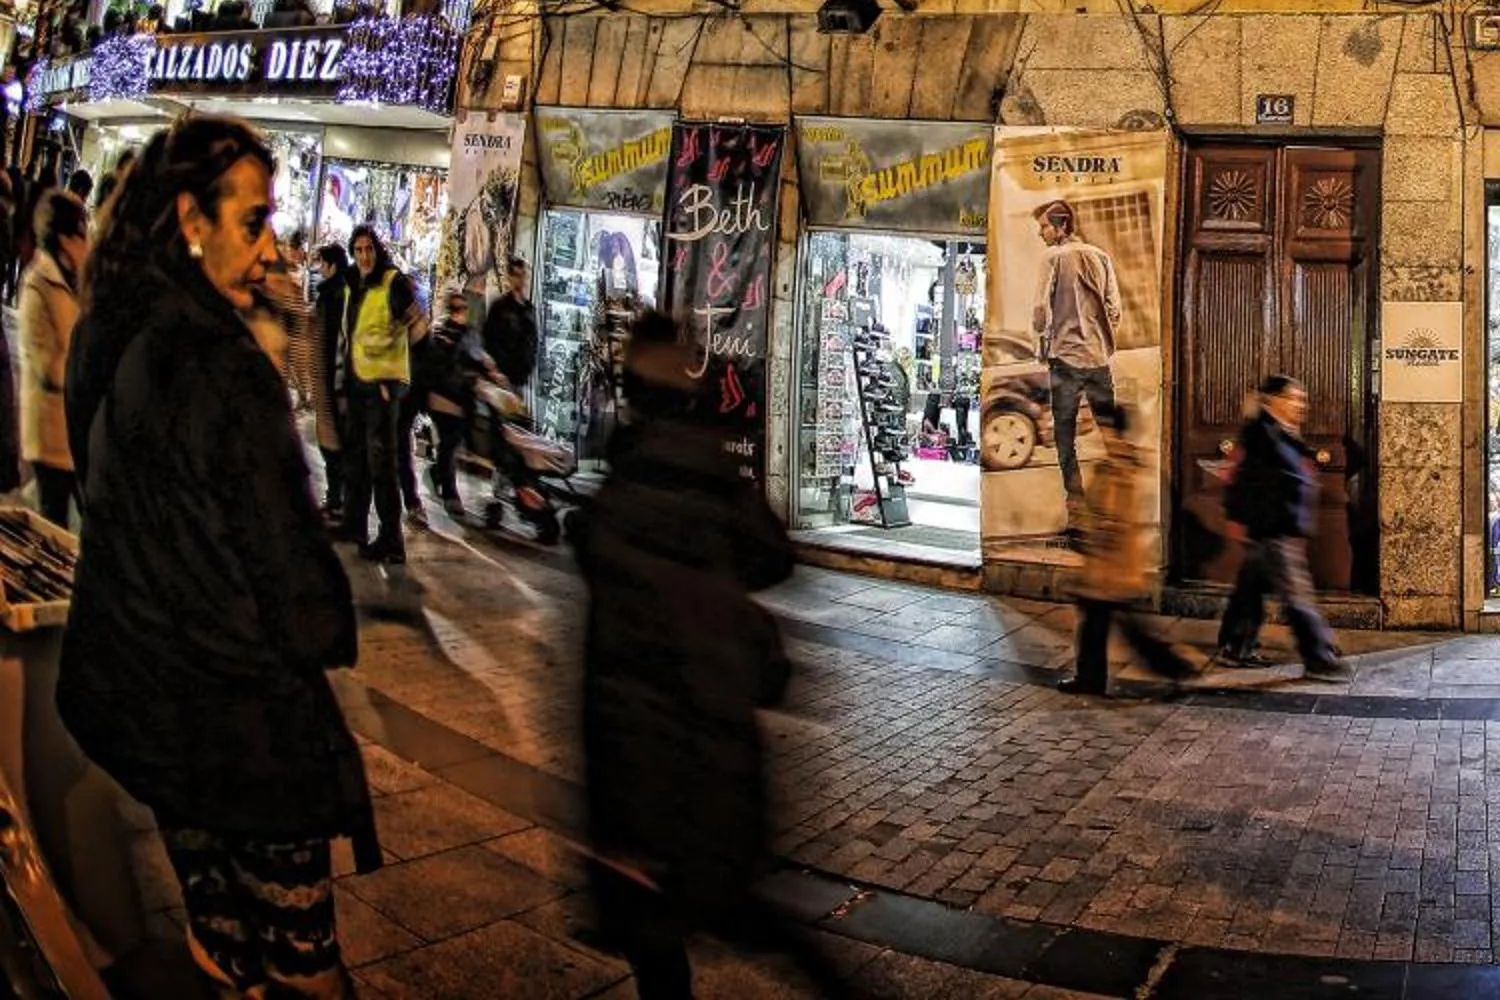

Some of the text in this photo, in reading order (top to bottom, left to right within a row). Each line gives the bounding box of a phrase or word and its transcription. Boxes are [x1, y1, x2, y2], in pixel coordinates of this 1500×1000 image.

[144, 37, 343, 80] CALZADOS DIEZ
[1263, 97, 1289, 115] 16
[464, 133, 511, 149] SENDRA
[1033, 155, 1122, 173] SENDRA
[665, 182, 769, 241] Beth
[707, 242, 738, 297] &
[1385, 348, 1459, 361] SUNGATE
